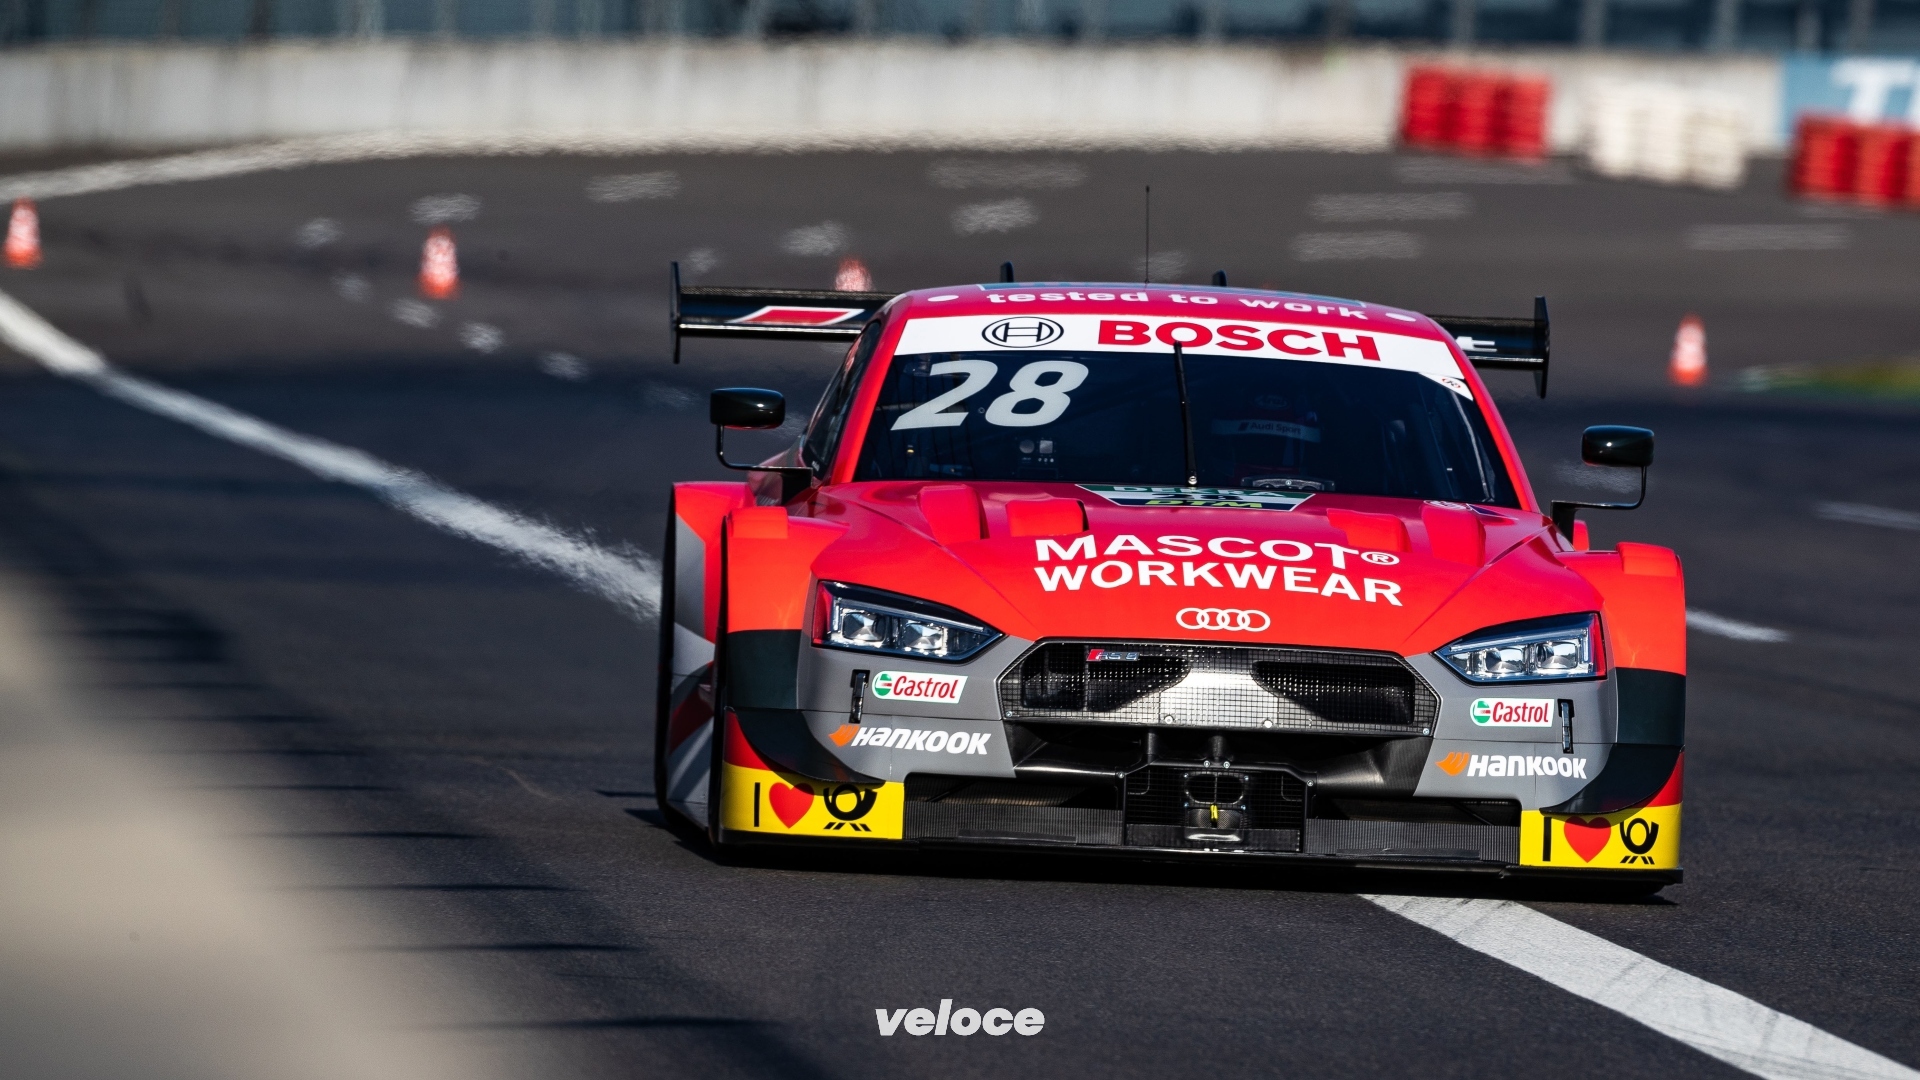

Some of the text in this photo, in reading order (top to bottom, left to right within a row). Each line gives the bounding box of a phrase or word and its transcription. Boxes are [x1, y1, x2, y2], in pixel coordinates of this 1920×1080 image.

[986, 291, 1369, 320] tested to work
[1097, 319, 1381, 361] BOSCH
[890, 359, 1090, 431] 28
[1145, 499, 1263, 508] DTM
[1033, 560, 1403, 607] WORKWEAR
[892, 674, 958, 700] Castrol
[1492, 701, 1549, 724] Castrol
